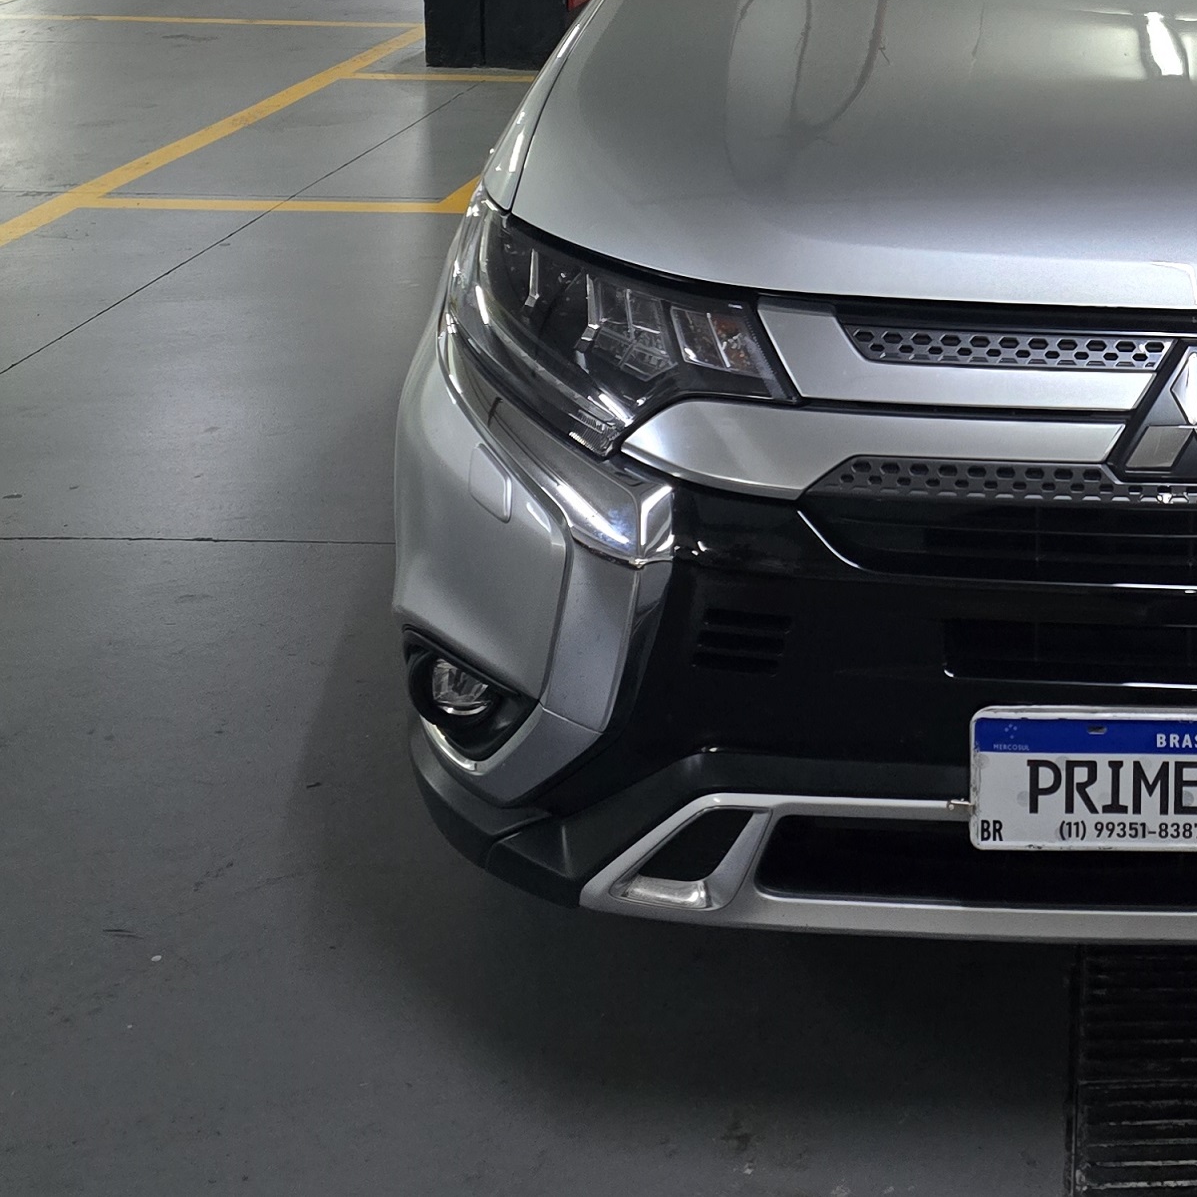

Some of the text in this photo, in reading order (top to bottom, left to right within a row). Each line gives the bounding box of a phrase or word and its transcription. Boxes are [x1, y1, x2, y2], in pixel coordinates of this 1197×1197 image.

[993, 743, 1030, 751] MERCOSUL
[980, 819, 1004, 842] BR
[1059, 820, 1087, 841] (11)
